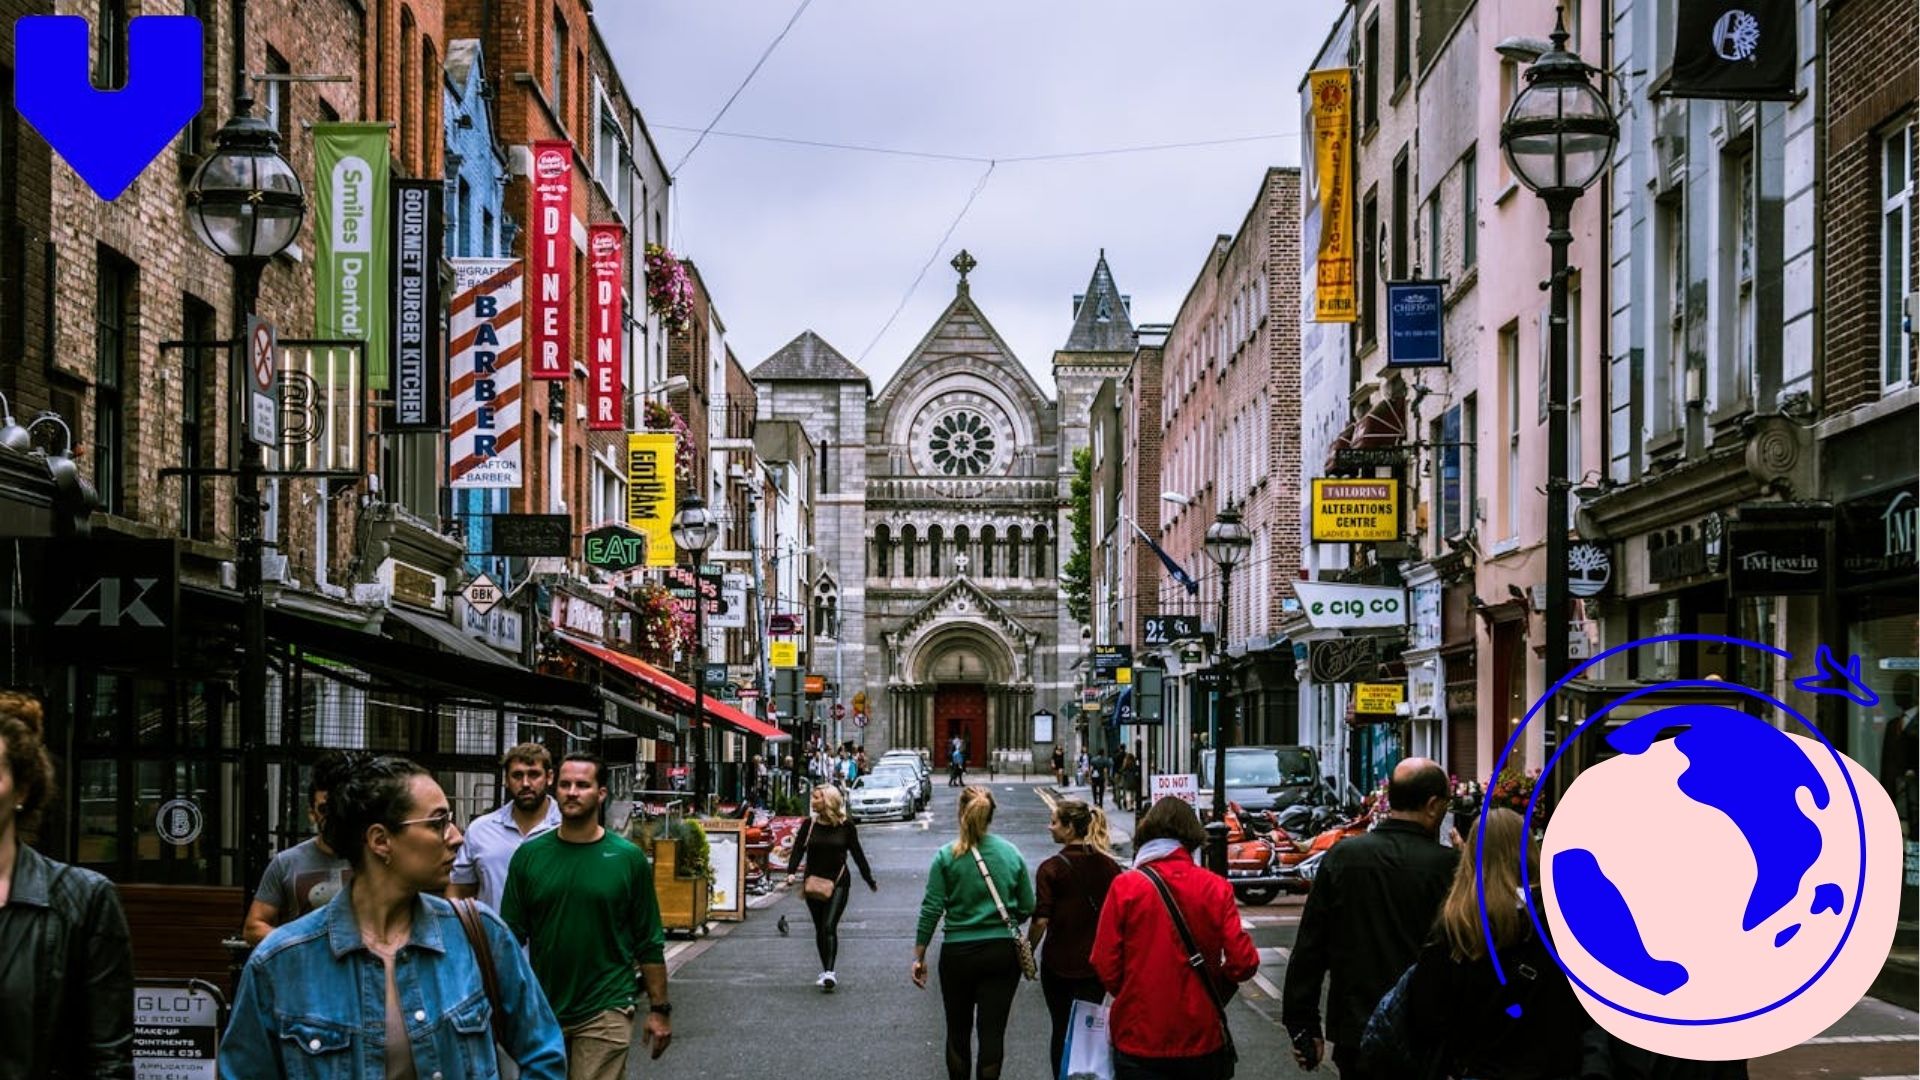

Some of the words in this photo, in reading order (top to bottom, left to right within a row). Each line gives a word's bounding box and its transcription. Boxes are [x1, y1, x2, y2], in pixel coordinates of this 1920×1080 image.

[342, 169, 363, 244] Smiles
[1329, 141, 1341, 254] ALTERATION
[403, 188, 422, 272] GOURMET
[341, 258, 363, 337] Dental
[402, 276, 421, 344] BURGER
[542, 206, 560, 370] DINER
[474, 295, 499, 457] BARBER
[597, 281, 613, 421] DINER
[277, 369, 325, 446] B
[402, 349, 421, 424] KITCHEN
[467, 473, 512, 482] BARBER
[631, 450, 667, 519] GOTHAM
[1327, 486, 1386, 498] TAILORING
[1320, 530, 1350, 538] LADIES
[1362, 530, 1393, 538] GENTS
[1321, 504, 1393, 514] ALTERATIONS
[1336, 517, 1377, 528] CENTRE
[588, 535, 641, 564] EAT
[54, 577, 167, 627] AK
[471, 589, 494, 600] GBK
[1311, 601, 1324, 616] e
[1330, 600, 1364, 619] cig
[1370, 598, 1399, 613] co
[1159, 777, 1170, 788] DO
[1172, 777, 1189, 788] NOT
[137, 997, 208, 1012] GLOT
